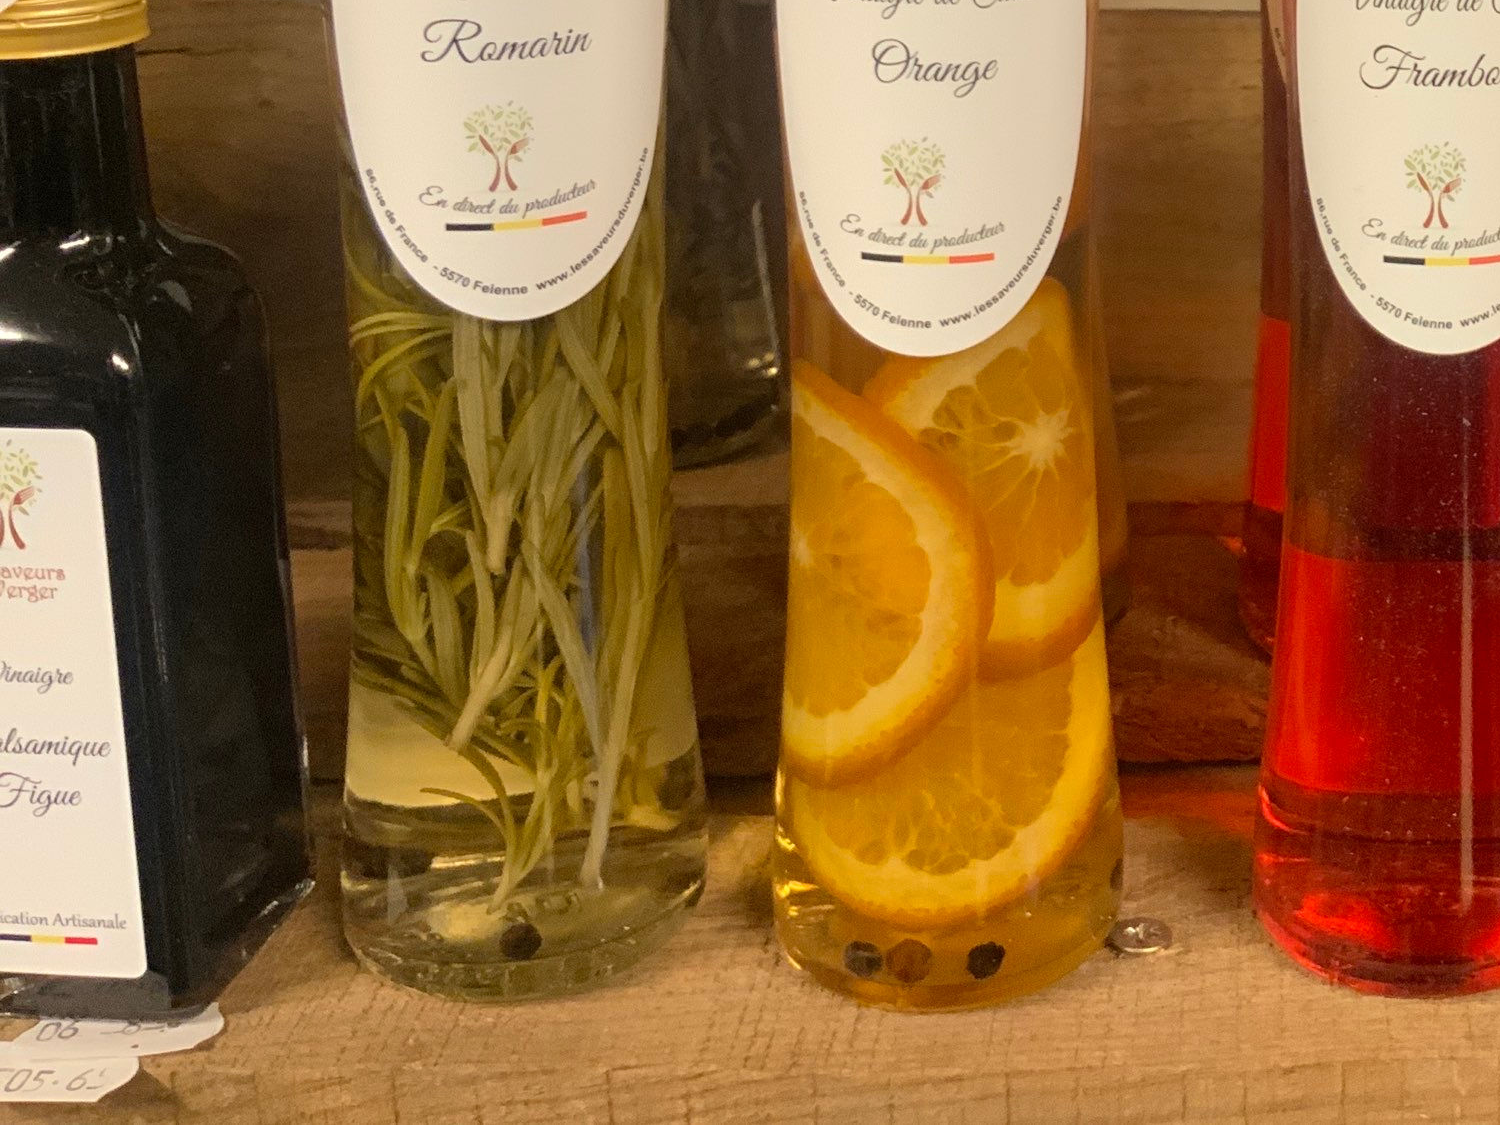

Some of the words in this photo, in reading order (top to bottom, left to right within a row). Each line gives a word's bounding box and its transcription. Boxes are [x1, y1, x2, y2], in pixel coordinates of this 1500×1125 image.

[420, 18, 592, 63] Romarin
[871, 38, 998, 97] Orange
[419, 185, 448, 208] En
[453, 197, 495, 214] direct
[499, 197, 518, 214] du
[522, 178, 597, 218] producteur
[385, 210, 396, 224] de
[395, 225, 428, 263] France
[440, 267, 471, 288] 5570
[840, 213, 865, 237] En
[868, 228, 907, 246] direct
[909, 233, 929, 248] du
[930, 221, 1005, 254] producteur
[1362, 218, 1387, 238] En
[1390, 231, 1428, 249] direct
[1431, 235, 1450, 251] du
[812, 232, 821, 247] de
[820, 248, 845, 287] France
[854, 294, 880, 316] 5570
[1332, 238, 1340, 252] de
[1340, 253, 1366, 291] France
[1376, 297, 1402, 318] 5570
[0, 565, 66, 581] aveurs
[0, 728, 111, 766] lsamique
[0, 771, 81, 819] Figue
[52, 913, 127, 930] Artisanale
